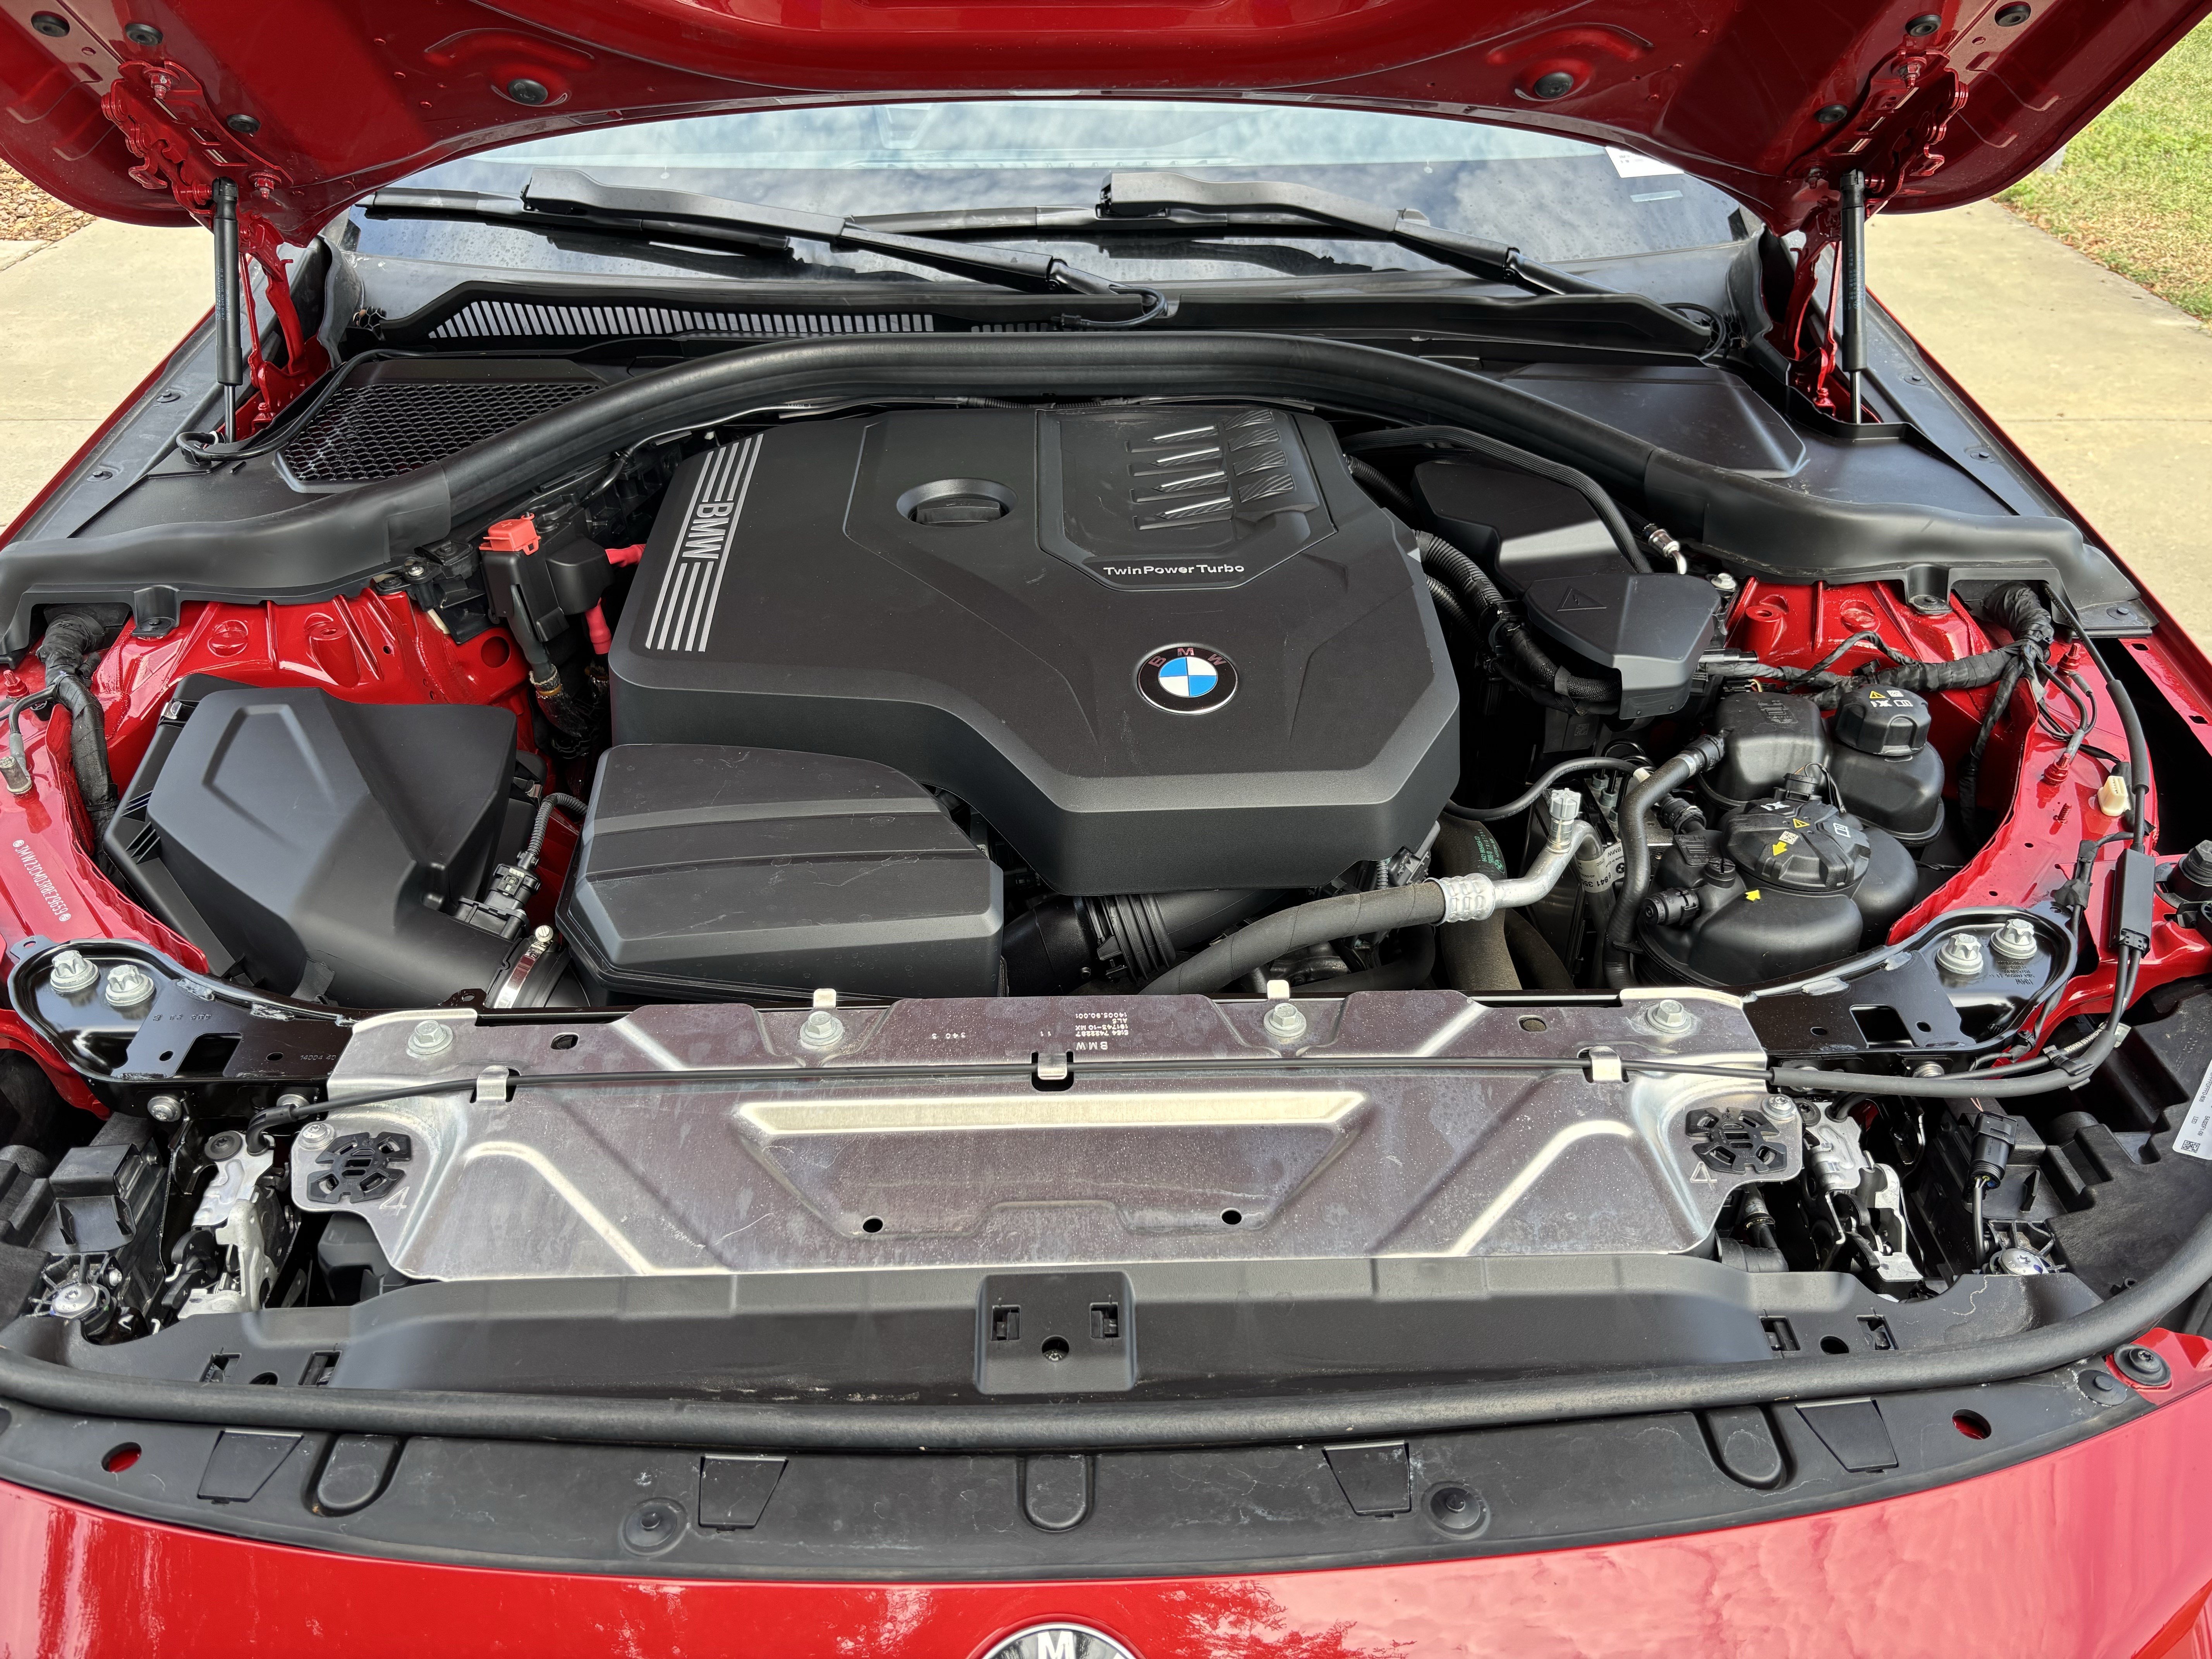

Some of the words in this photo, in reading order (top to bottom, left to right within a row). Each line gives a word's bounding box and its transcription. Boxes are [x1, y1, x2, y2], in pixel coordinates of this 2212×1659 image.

[682, 502, 734, 559] BMW
[1148, 647, 1226, 668] BMW
[1076, 1041, 1108, 1051] BMW
